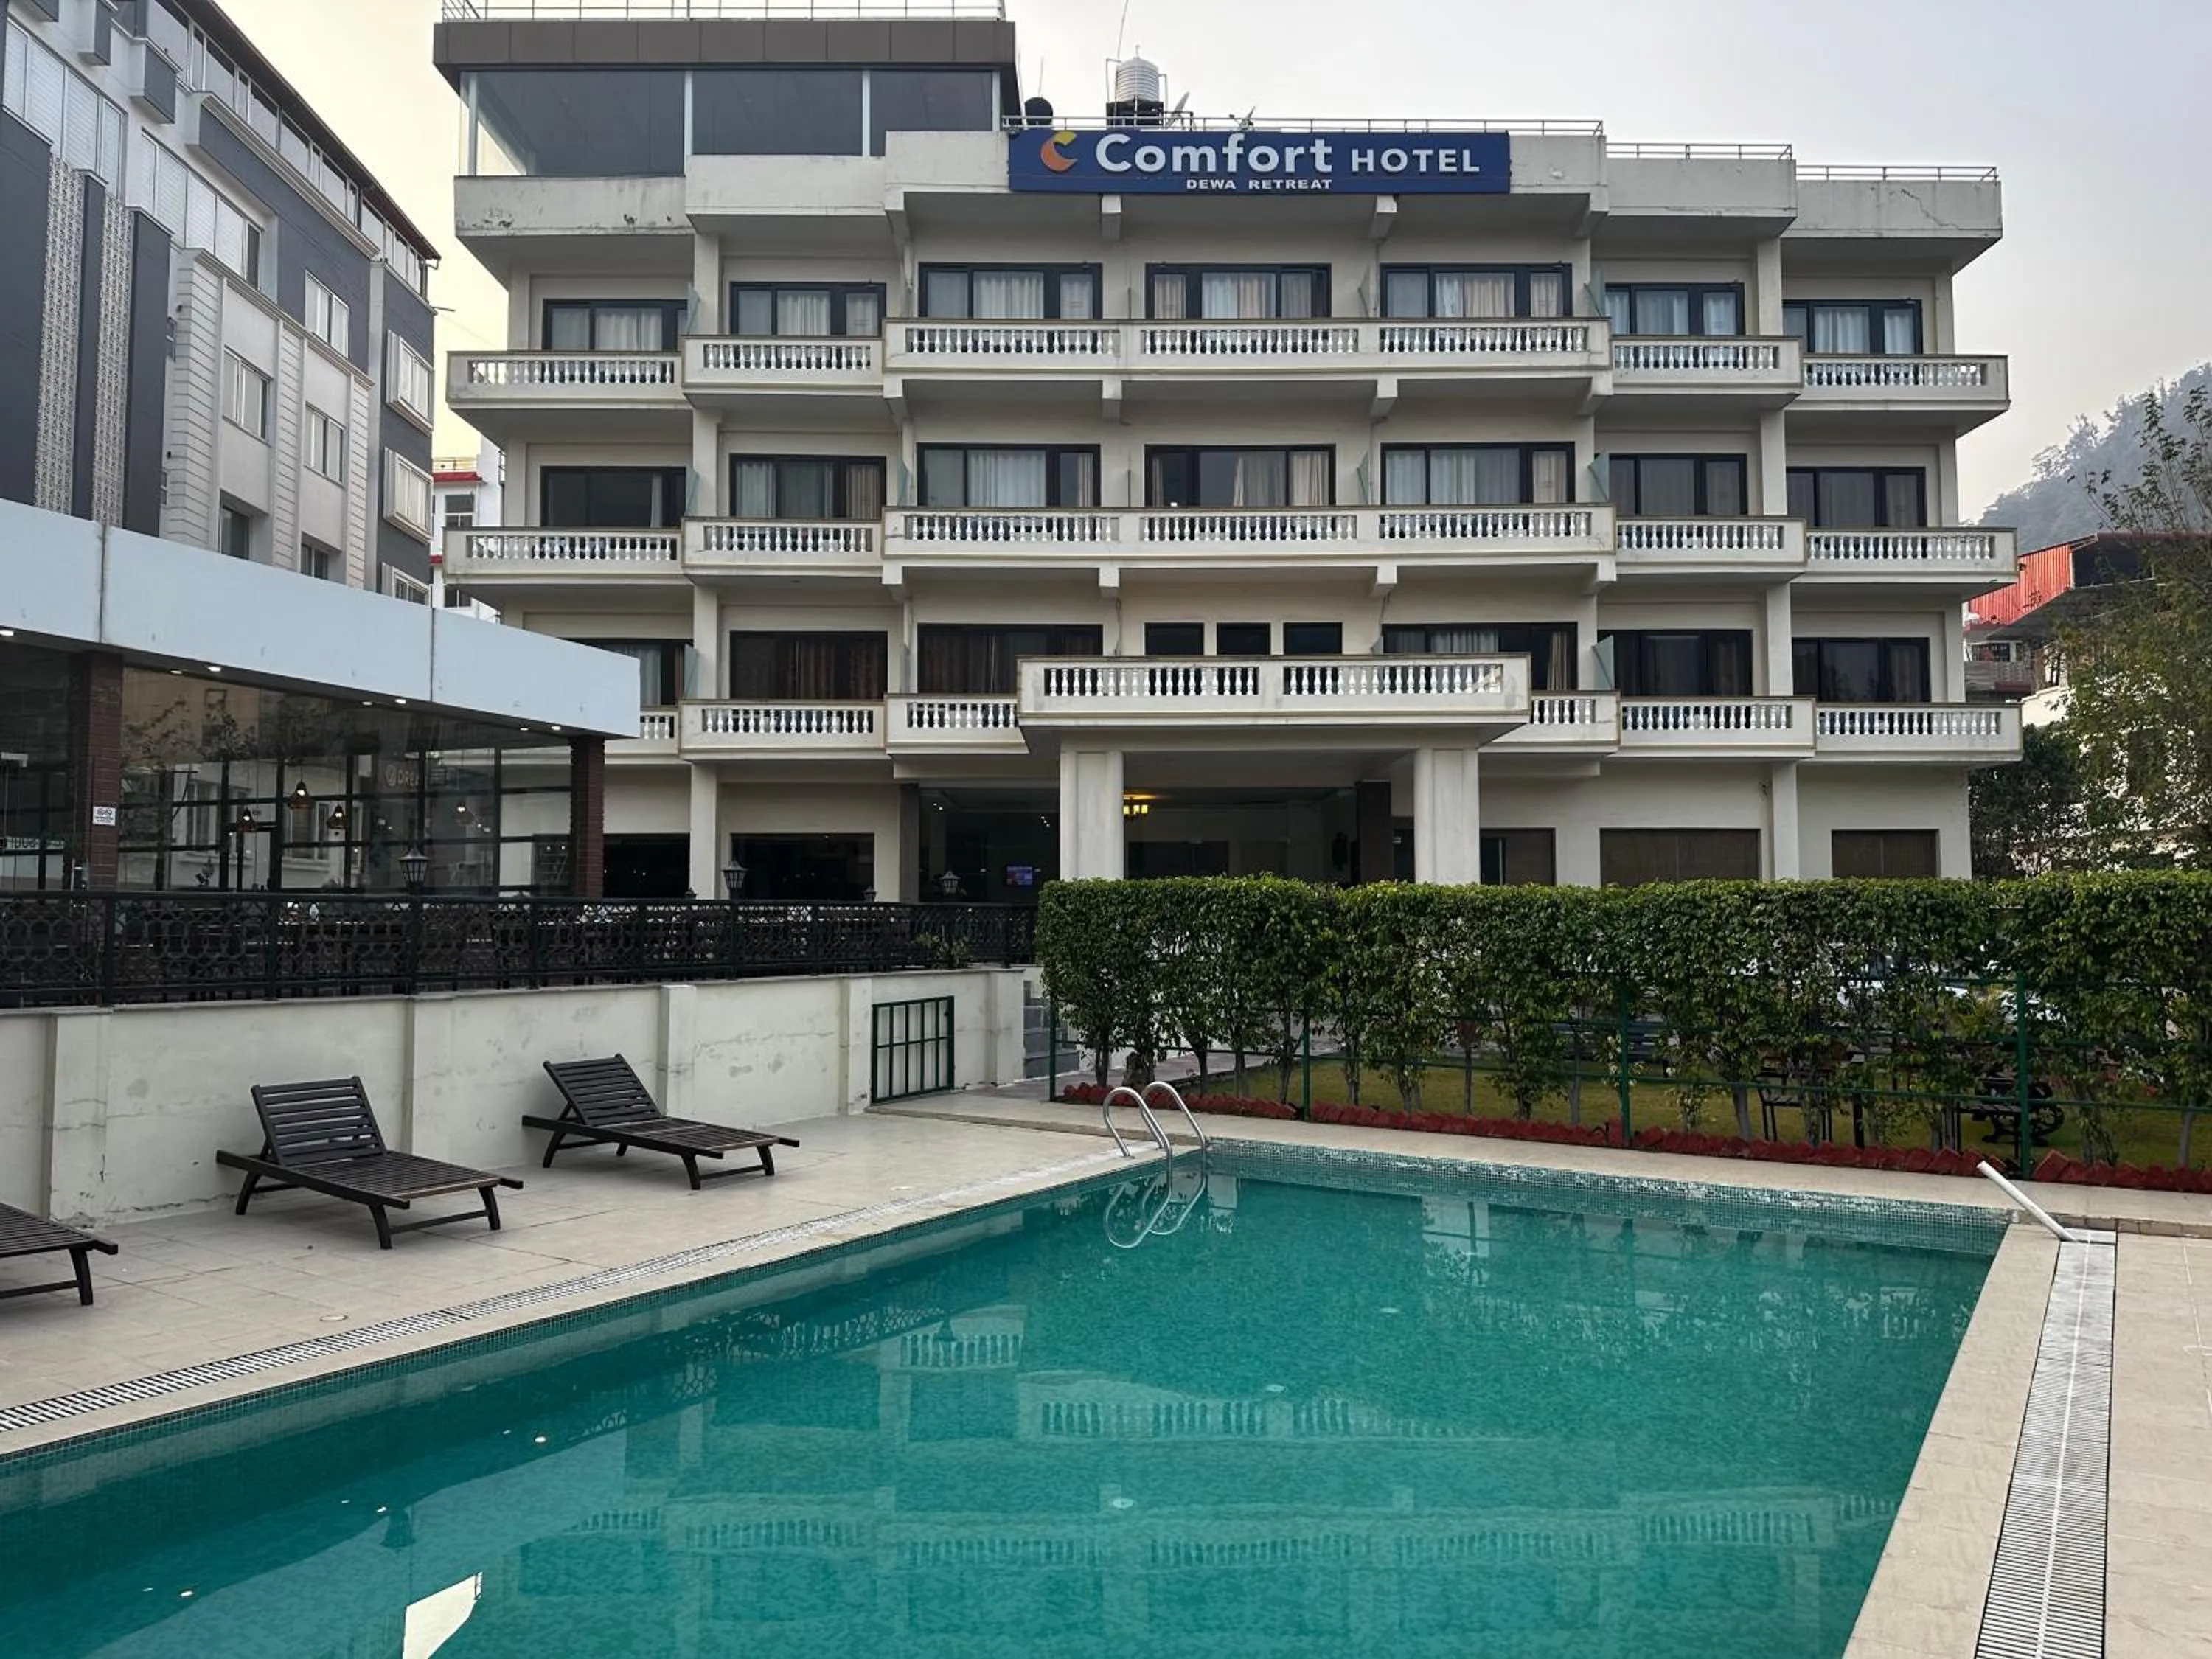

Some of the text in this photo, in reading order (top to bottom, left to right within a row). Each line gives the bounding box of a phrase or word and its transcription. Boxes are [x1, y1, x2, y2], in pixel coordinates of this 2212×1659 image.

[1095, 133, 1480, 173] Comfort HOTEL
[1186, 179, 1332, 189] DEWA RETREAT
